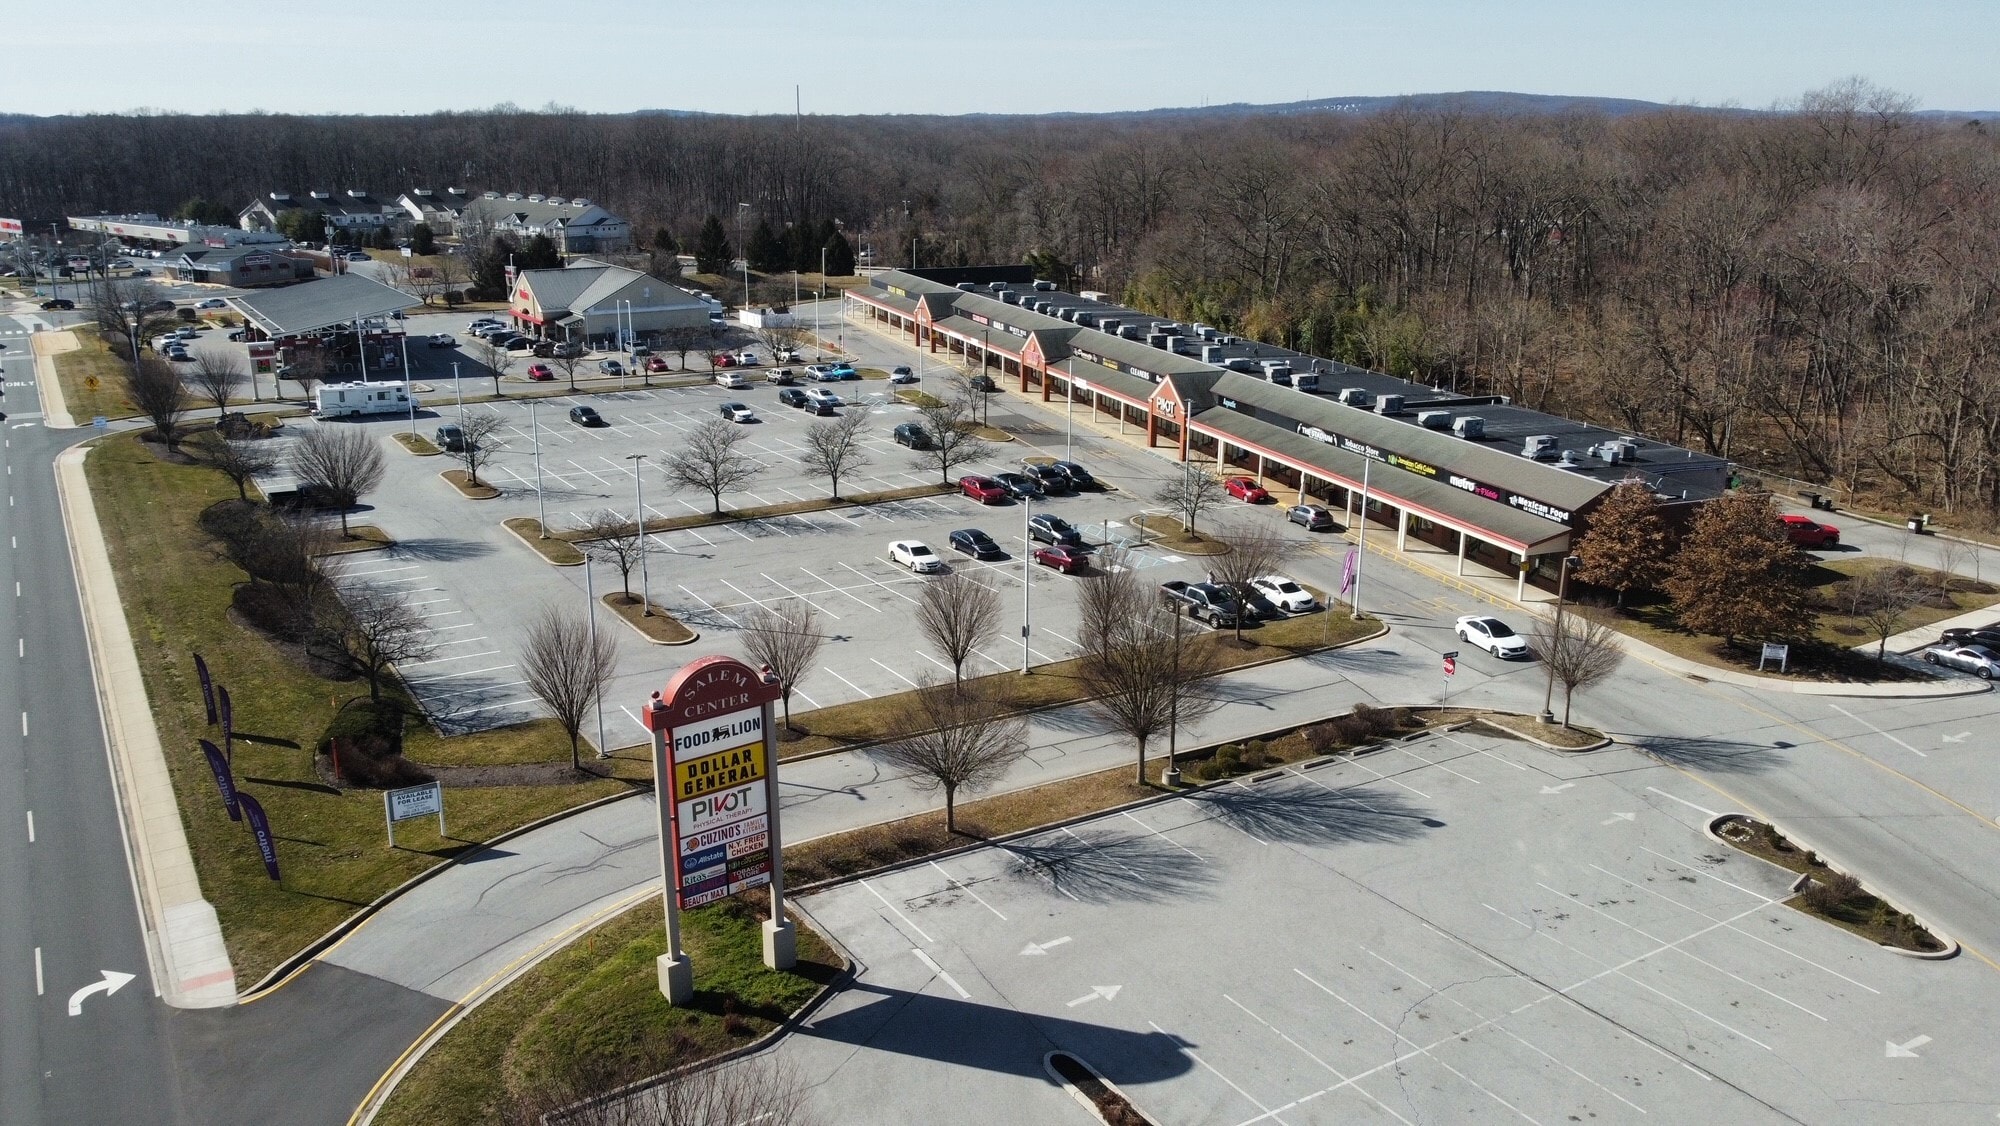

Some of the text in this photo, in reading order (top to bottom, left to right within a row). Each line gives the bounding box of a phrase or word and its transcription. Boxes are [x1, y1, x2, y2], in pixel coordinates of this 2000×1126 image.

[1130, 367, 1150, 380] CLEANERS
[1156, 397, 1175, 414] PIVOT
[1344, 438, 1364, 452] Tobacco
[1366, 445, 1379, 457] Store
[1449, 475, 1475, 492] metro
[1518, 496, 1569, 520] Mexican Food
[684, 669, 748, 700] SALEM
[684, 692, 749, 718] CENTER
[675, 717, 761, 751] FOOD LION
[687, 749, 753, 779] DOLLAR
[684, 763, 758, 796] GENERAL
[218, 775, 234, 806] metro
[397, 789, 433, 800] AVAILABLE
[412, 794, 433, 802] LEASE
[691, 786, 752, 822] PIVOT
[693, 808, 753, 830] PHYSICAL THERAPY
[700, 824, 741, 847] CUZINO'S
[744, 833, 766, 844] FRIED
[257, 830, 275, 863] metro
[731, 841, 764, 857] CHICKEN
[698, 851, 724, 865] Allstate
[684, 872, 707, 886] Rita's
[733, 862, 765, 877] TOBACCO
[737, 869, 760, 880] STORE
[683, 893, 709, 908] BEAUTY
[710, 888, 725, 899] MAX
